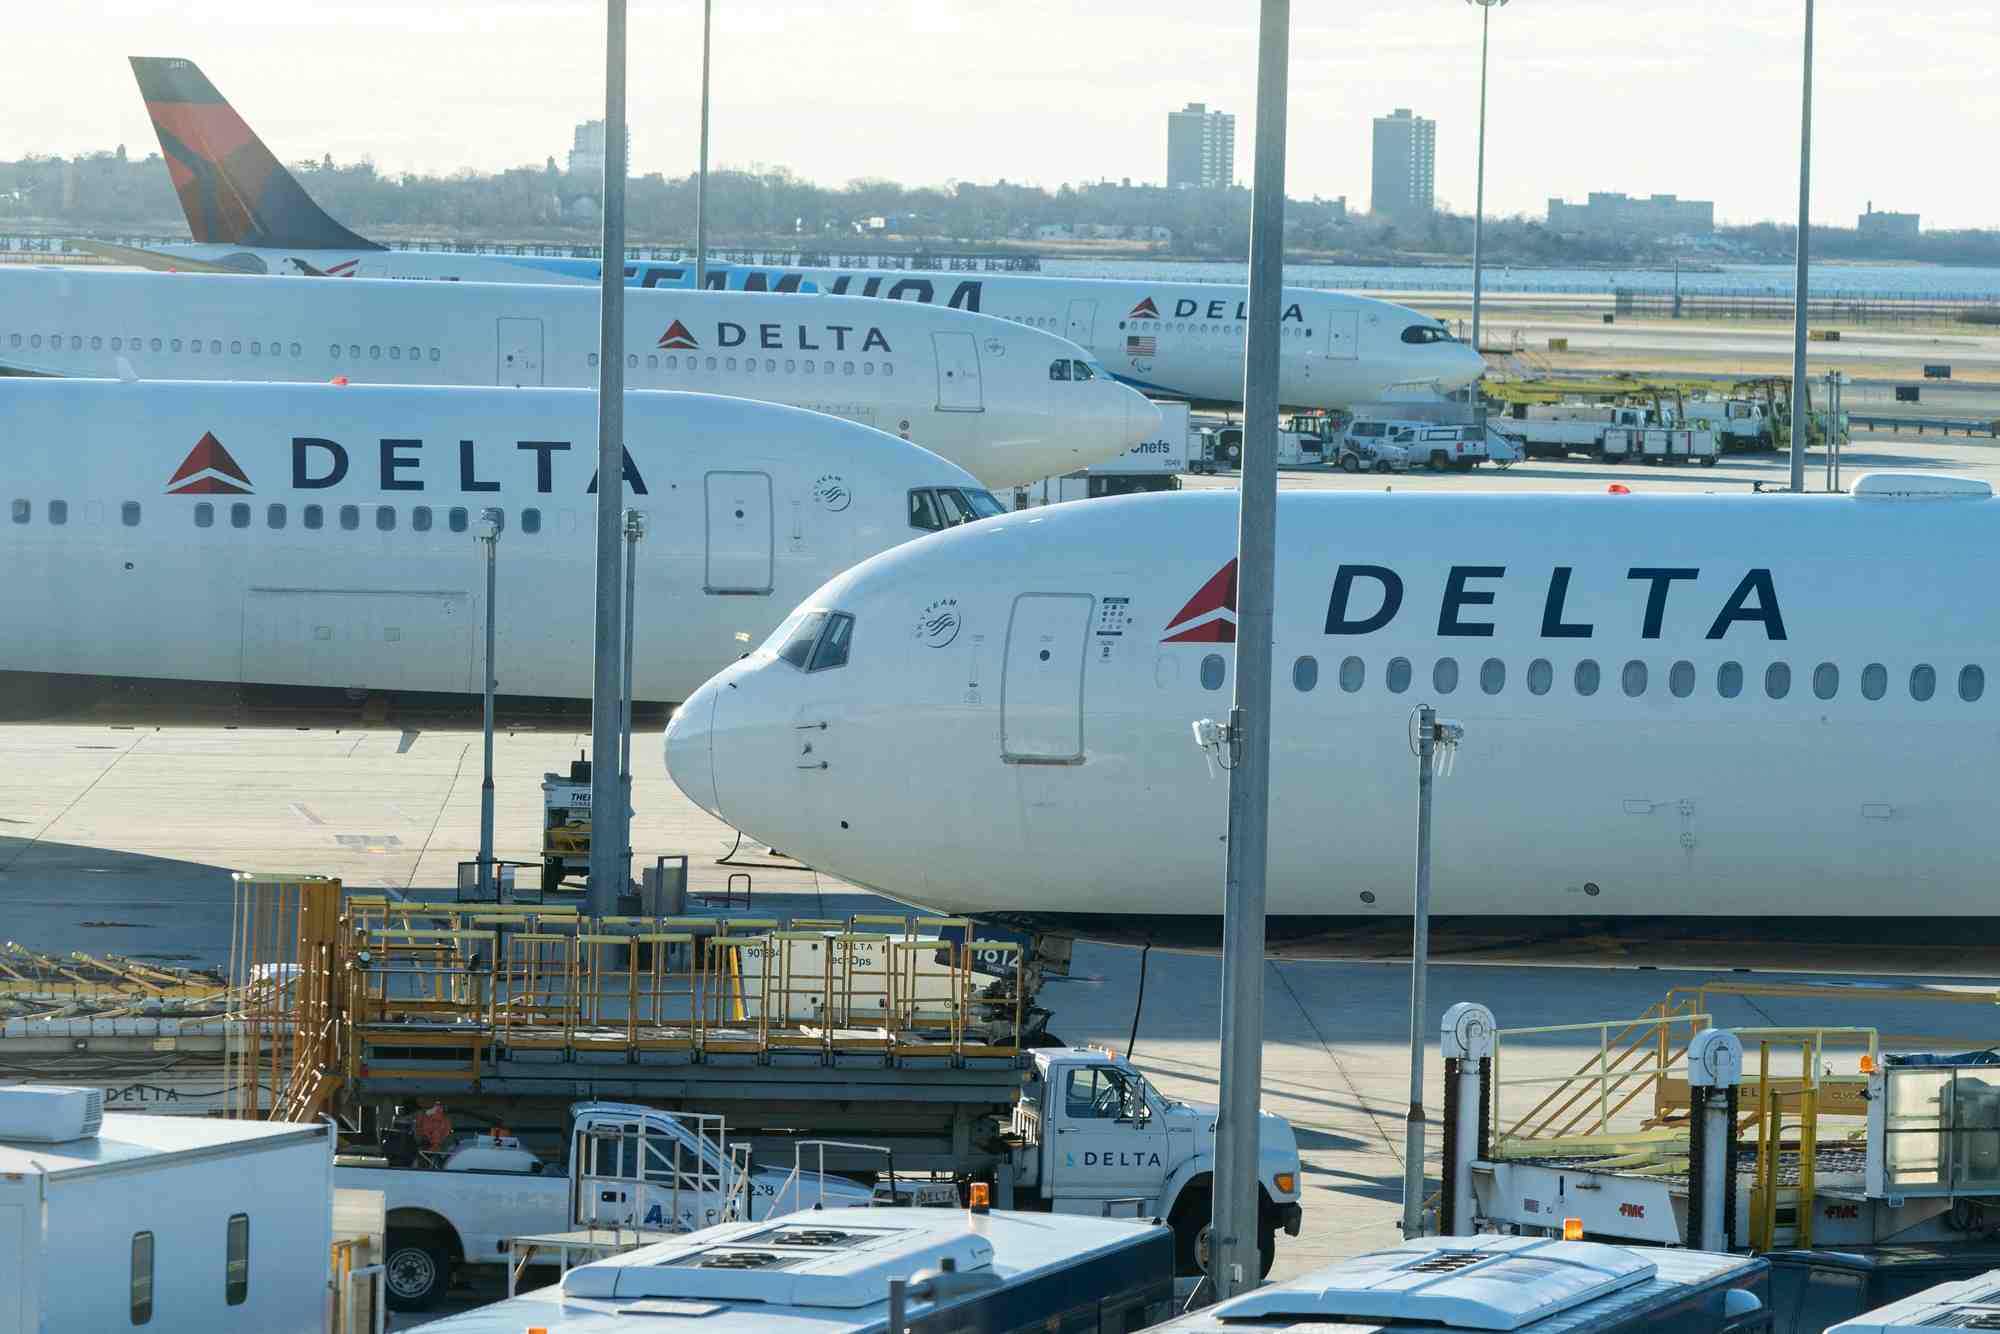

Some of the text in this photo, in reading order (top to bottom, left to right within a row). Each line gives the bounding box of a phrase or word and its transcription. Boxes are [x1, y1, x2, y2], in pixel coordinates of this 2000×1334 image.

[1175, 299, 1304, 322] DELA
[718, 321, 891, 352] DELTA
[1323, 564, 1788, 641] DELTA
[837, 943, 872, 951] DLTA
[107, 1088, 178, 1102] DELTA
[1084, 1151, 1161, 1167] DELTA
[1621, 1203, 1645, 1218] FMC
